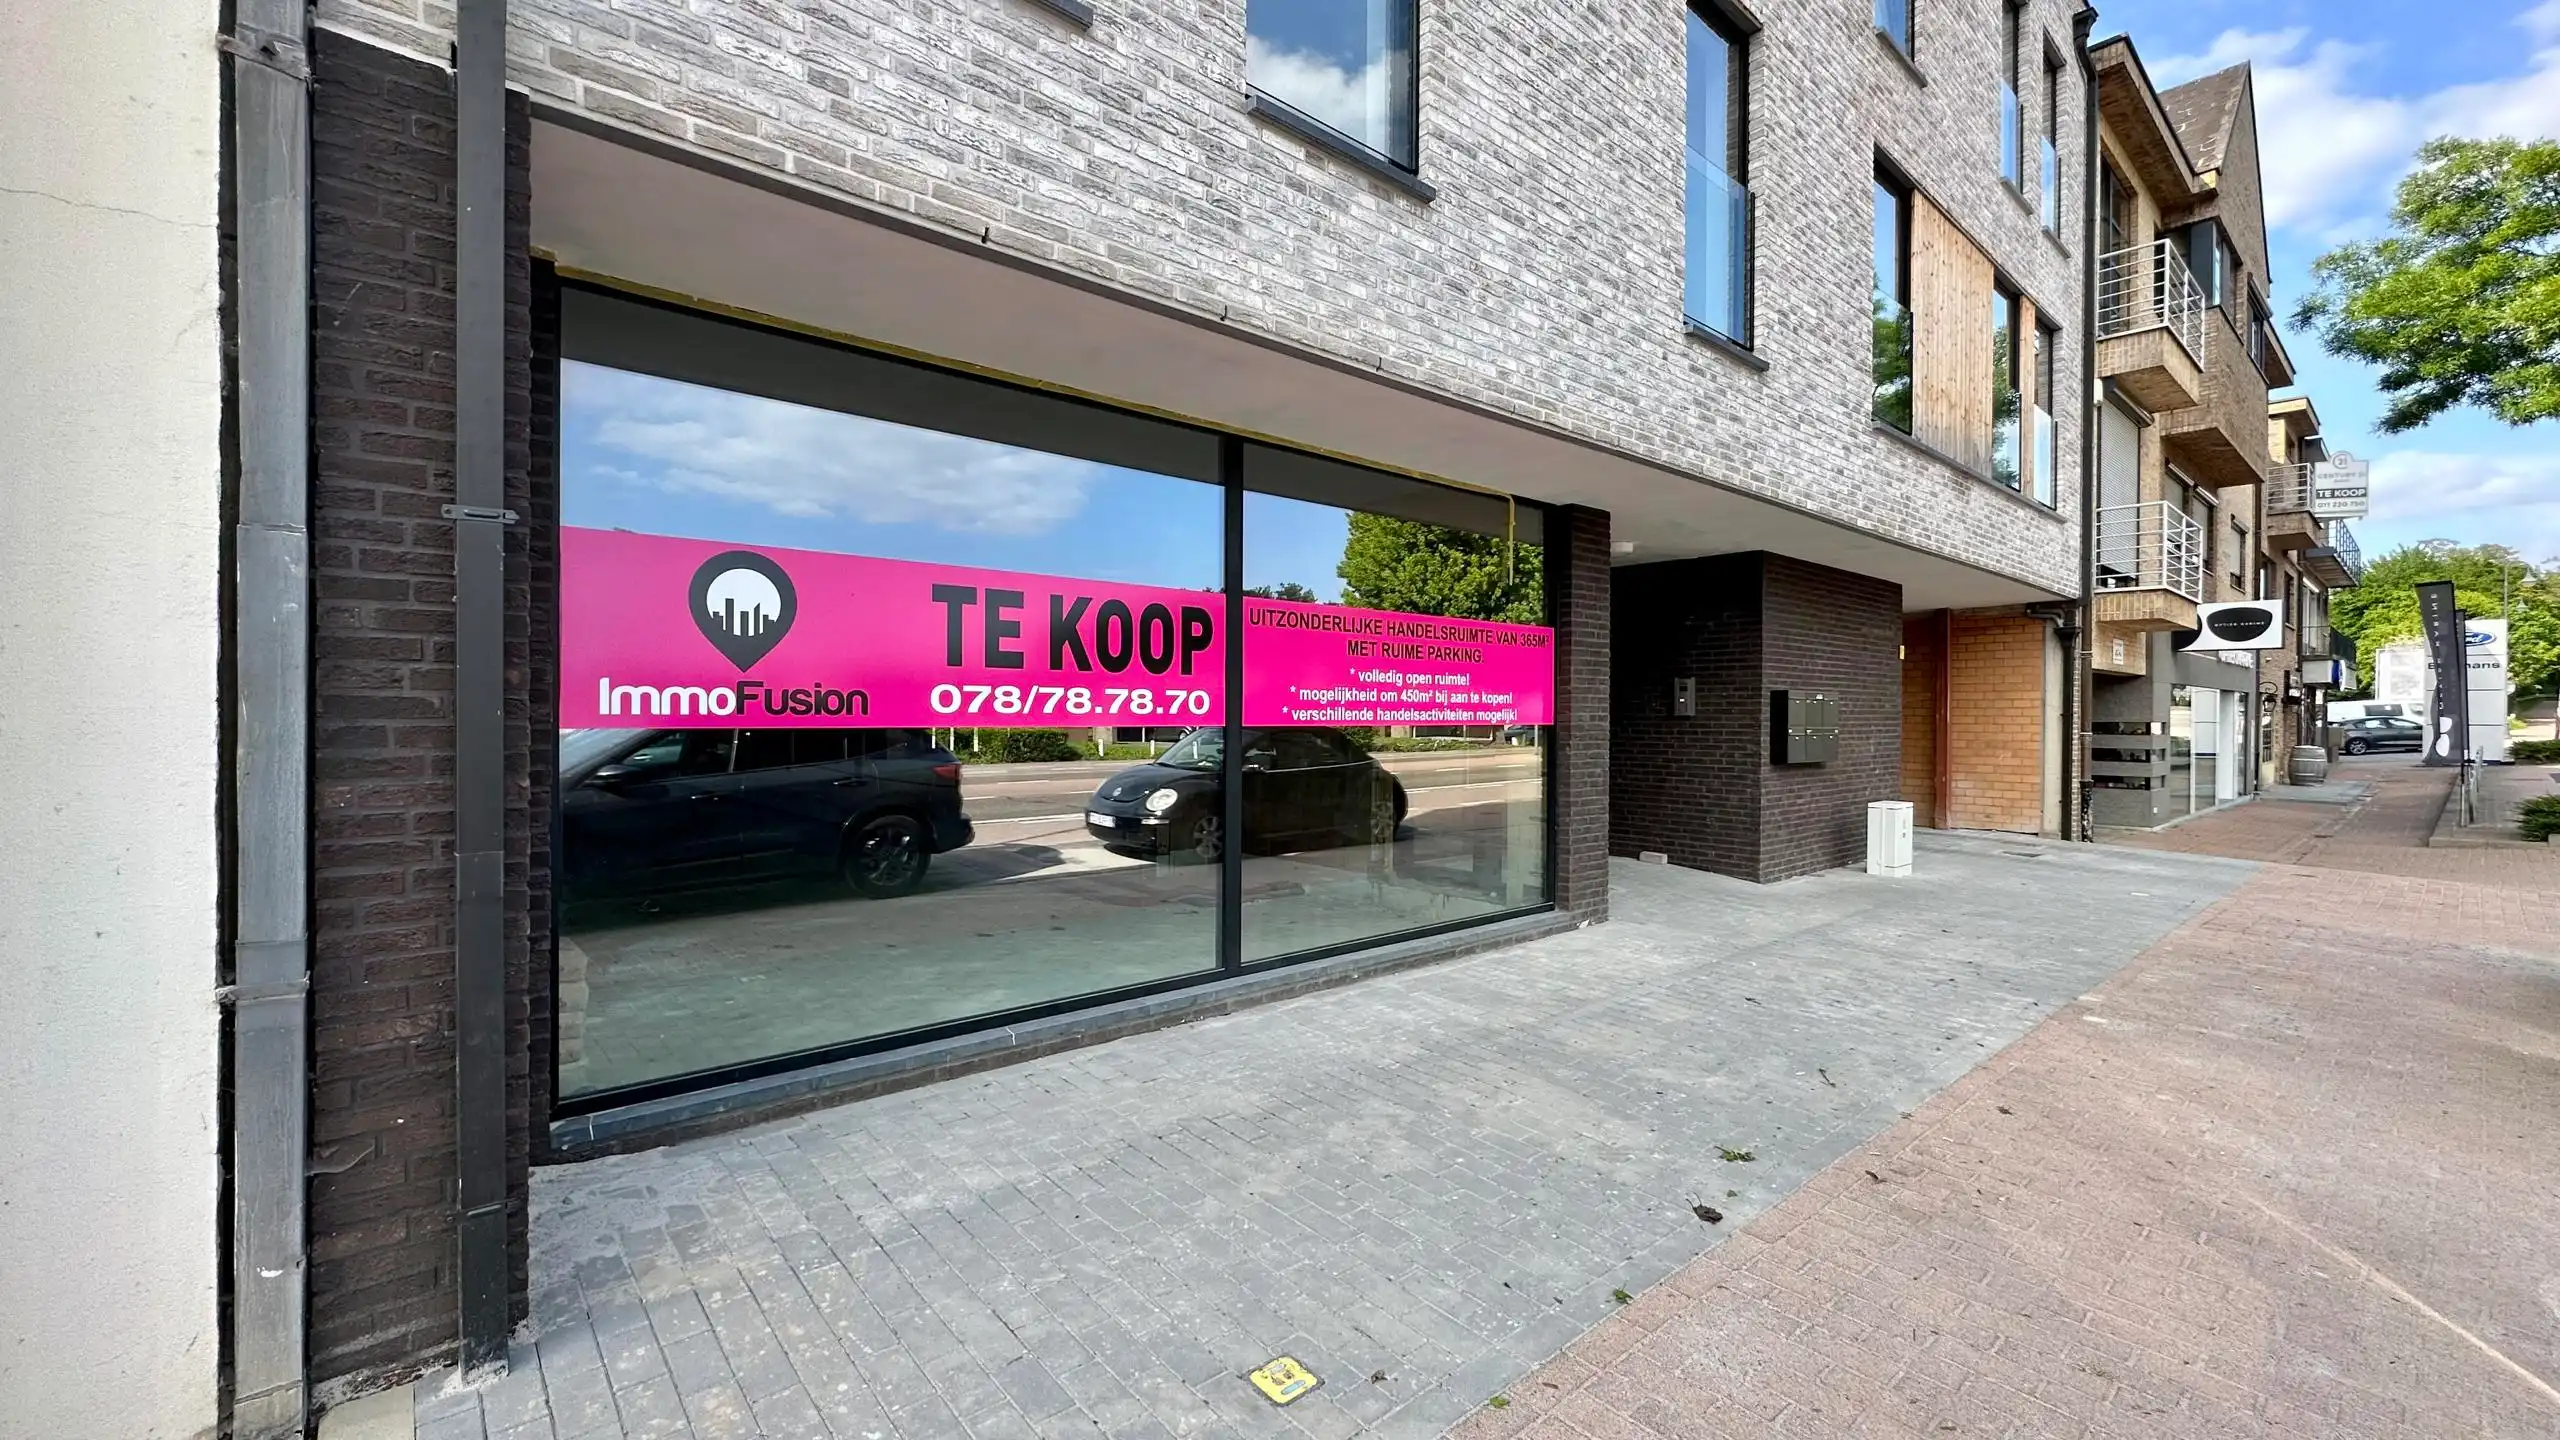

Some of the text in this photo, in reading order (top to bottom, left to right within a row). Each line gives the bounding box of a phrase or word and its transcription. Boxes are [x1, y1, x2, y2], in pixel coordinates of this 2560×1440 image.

[2317, 488, 2366, 498] TE KOOP
[931, 583, 1214, 677] TE KOOP
[1250, 607, 1383, 635] UITZONDERLIJKE
[1387, 622, 1493, 644] HANDELSRUIMTE
[1496, 631, 1518, 647] VAN
[1347, 640, 1485, 664] MET RUIME PARKING.
[1358, 670, 1470, 686] volledig open ruimte!
[599, 676, 869, 717] ImmoFusion
[929, 683, 1212, 716] 078/78.78.70
[1299, 686, 1377, 704] mogelijkheid
[1380, 690, 1398, 702] om
[1435, 690, 1449, 704] bij
[1450, 693, 1467, 703] aan
[1470, 692, 1479, 703] te
[1481, 692, 1513, 706] kopen!
[1291, 707, 1518, 723] verschillende handelsactiviteiten mogelijk!
